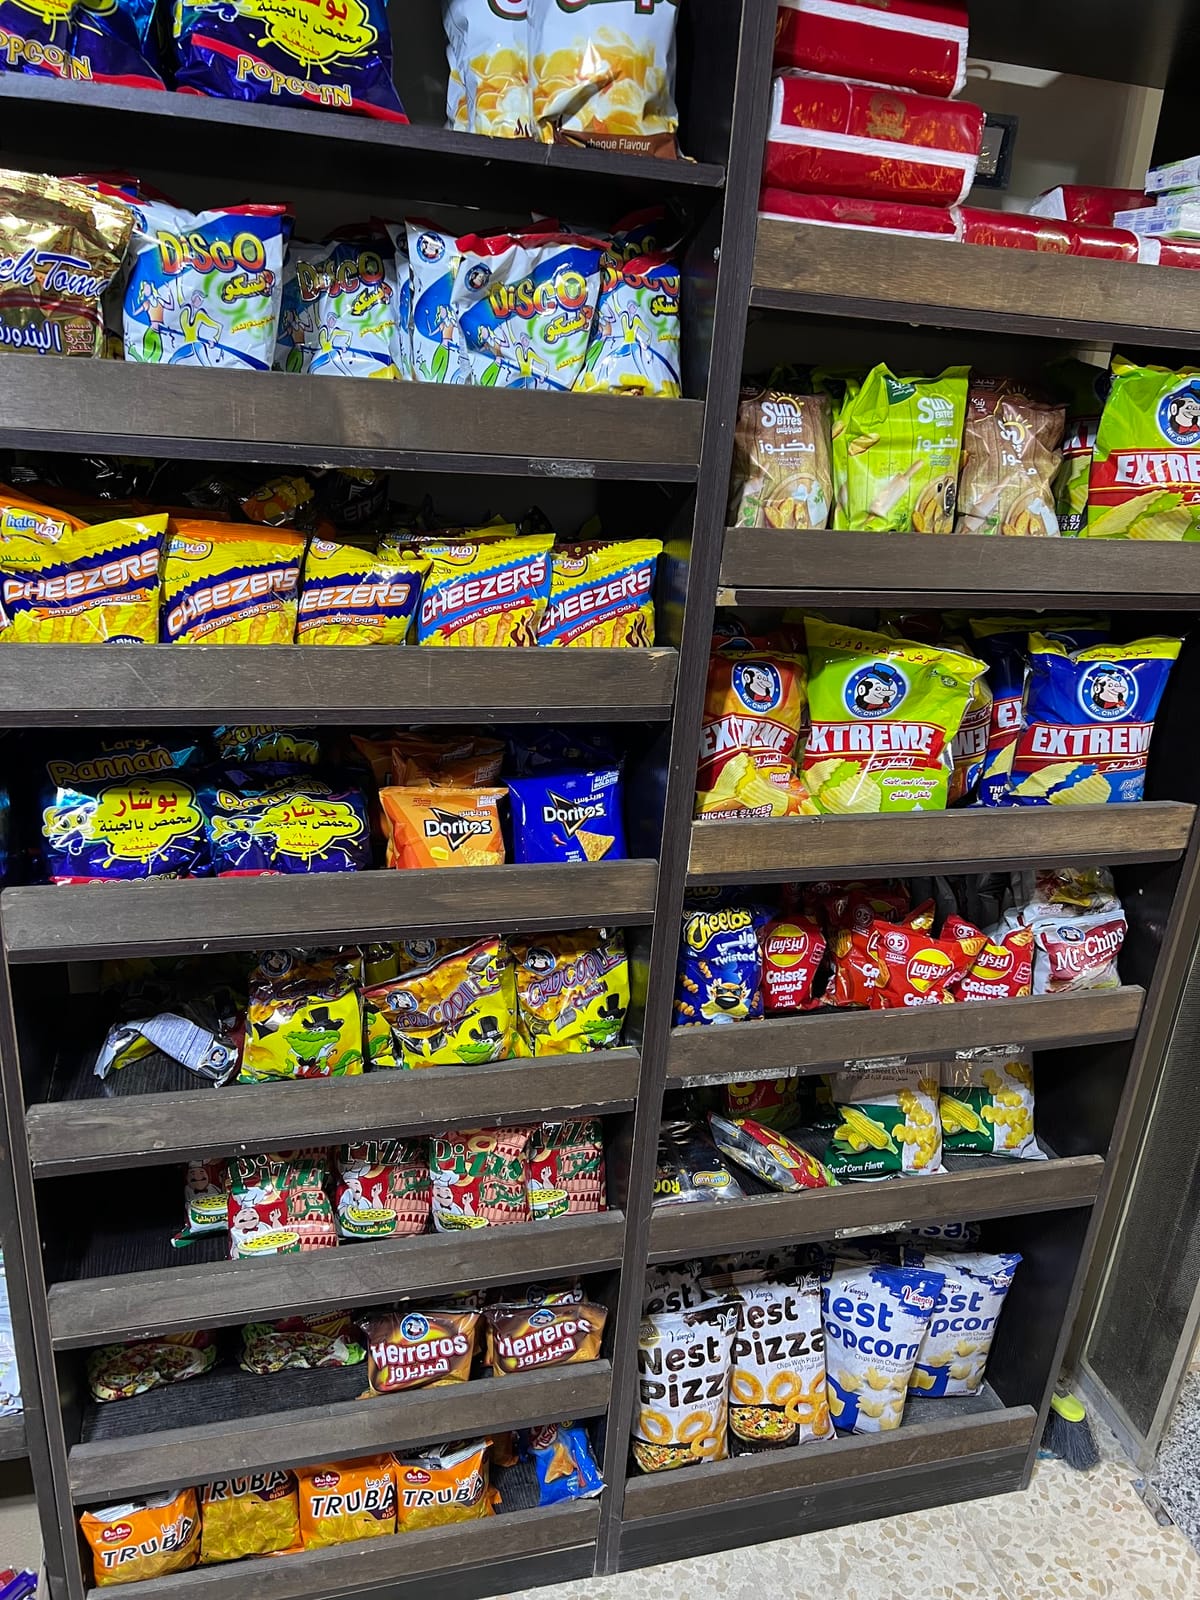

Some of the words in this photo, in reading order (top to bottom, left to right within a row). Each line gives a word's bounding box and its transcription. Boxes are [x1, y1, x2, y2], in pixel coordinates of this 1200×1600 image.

[313, 24, 361, 44] محمص
[619, 138, 651, 151] Flavour
[761, 402, 801, 427] Sun
[918, 397, 955, 423] Sun
[7, 514, 35, 530] hala
[4, 549, 160, 603] CHEEZERS
[48, 605, 87, 615] NATURAL
[90, 597, 113, 607] CORN
[168, 568, 299, 635] CHEEZERS
[421, 561, 545, 626] CHEEZERS
[200, 615, 236, 632] NATURAL
[238, 607, 260, 618] CORN
[449, 612, 482, 629] NATURAL
[483, 605, 502, 614] CORN
[503, 599, 526, 609] CHIPS
[567, 618, 598, 638] NATURAL
[599, 610, 617, 620] CORN
[807, 722, 935, 754] XTREME
[47, 748, 174, 787] Rannan
[112, 786, 177, 818] بوشار
[543, 803, 605, 822] Doritos
[740, 804, 773, 816] SLICES
[148, 815, 193, 832] محمص
[312, 818, 353, 830] محمص
[424, 819, 493, 837] Doritos
[686, 908, 752, 949] Cheetos
[711, 950, 756, 966] Twisted
[1056, 946, 1085, 972] Mr.
[1085, 927, 1125, 957] Chips
[847, 1163, 863, 1174] Corn
[933, 1291, 984, 1313] est
[500, 1319, 592, 1358] Herreros
[825, 1321, 920, 1360] opcorn
[927, 1317, 998, 1338] pcor
[370, 1333, 470, 1371] Herreros
[637, 1336, 721, 1375] Nest
[855, 1353, 871, 1362] Chips
[200, 1469, 289, 1504] TRUBA
[311, 1482, 396, 1518] TRUBA
